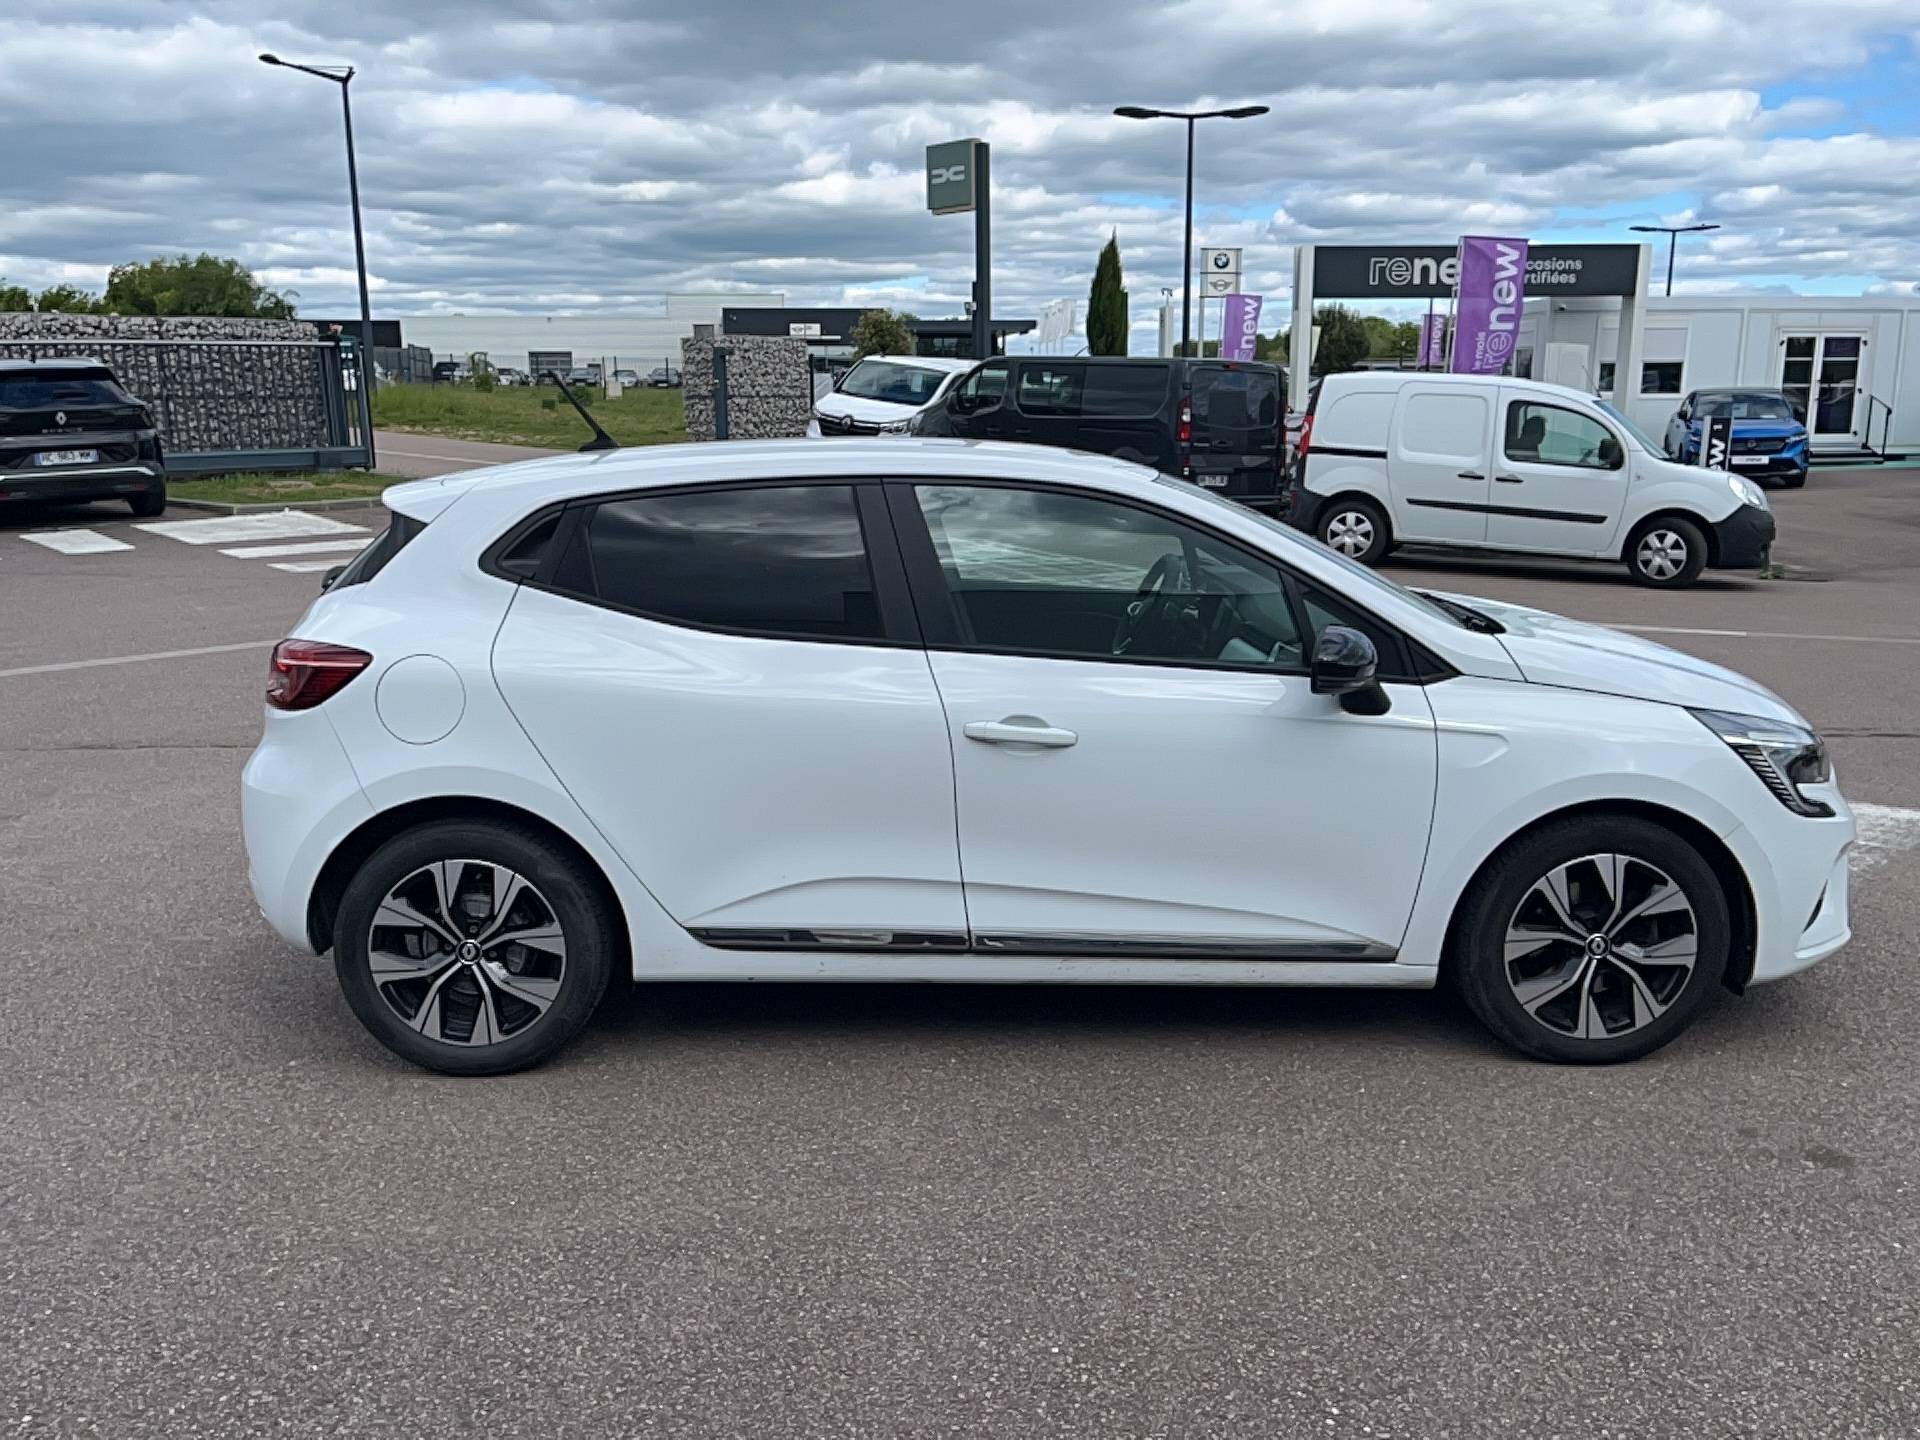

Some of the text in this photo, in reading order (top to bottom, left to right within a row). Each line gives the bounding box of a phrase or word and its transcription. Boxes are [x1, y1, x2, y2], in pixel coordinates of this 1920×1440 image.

[1369, 256, 1458, 286] rene
[1526, 257, 1583, 271] casions
[1524, 271, 1577, 284] rtifiées
[1482, 243, 1521, 370] renew
